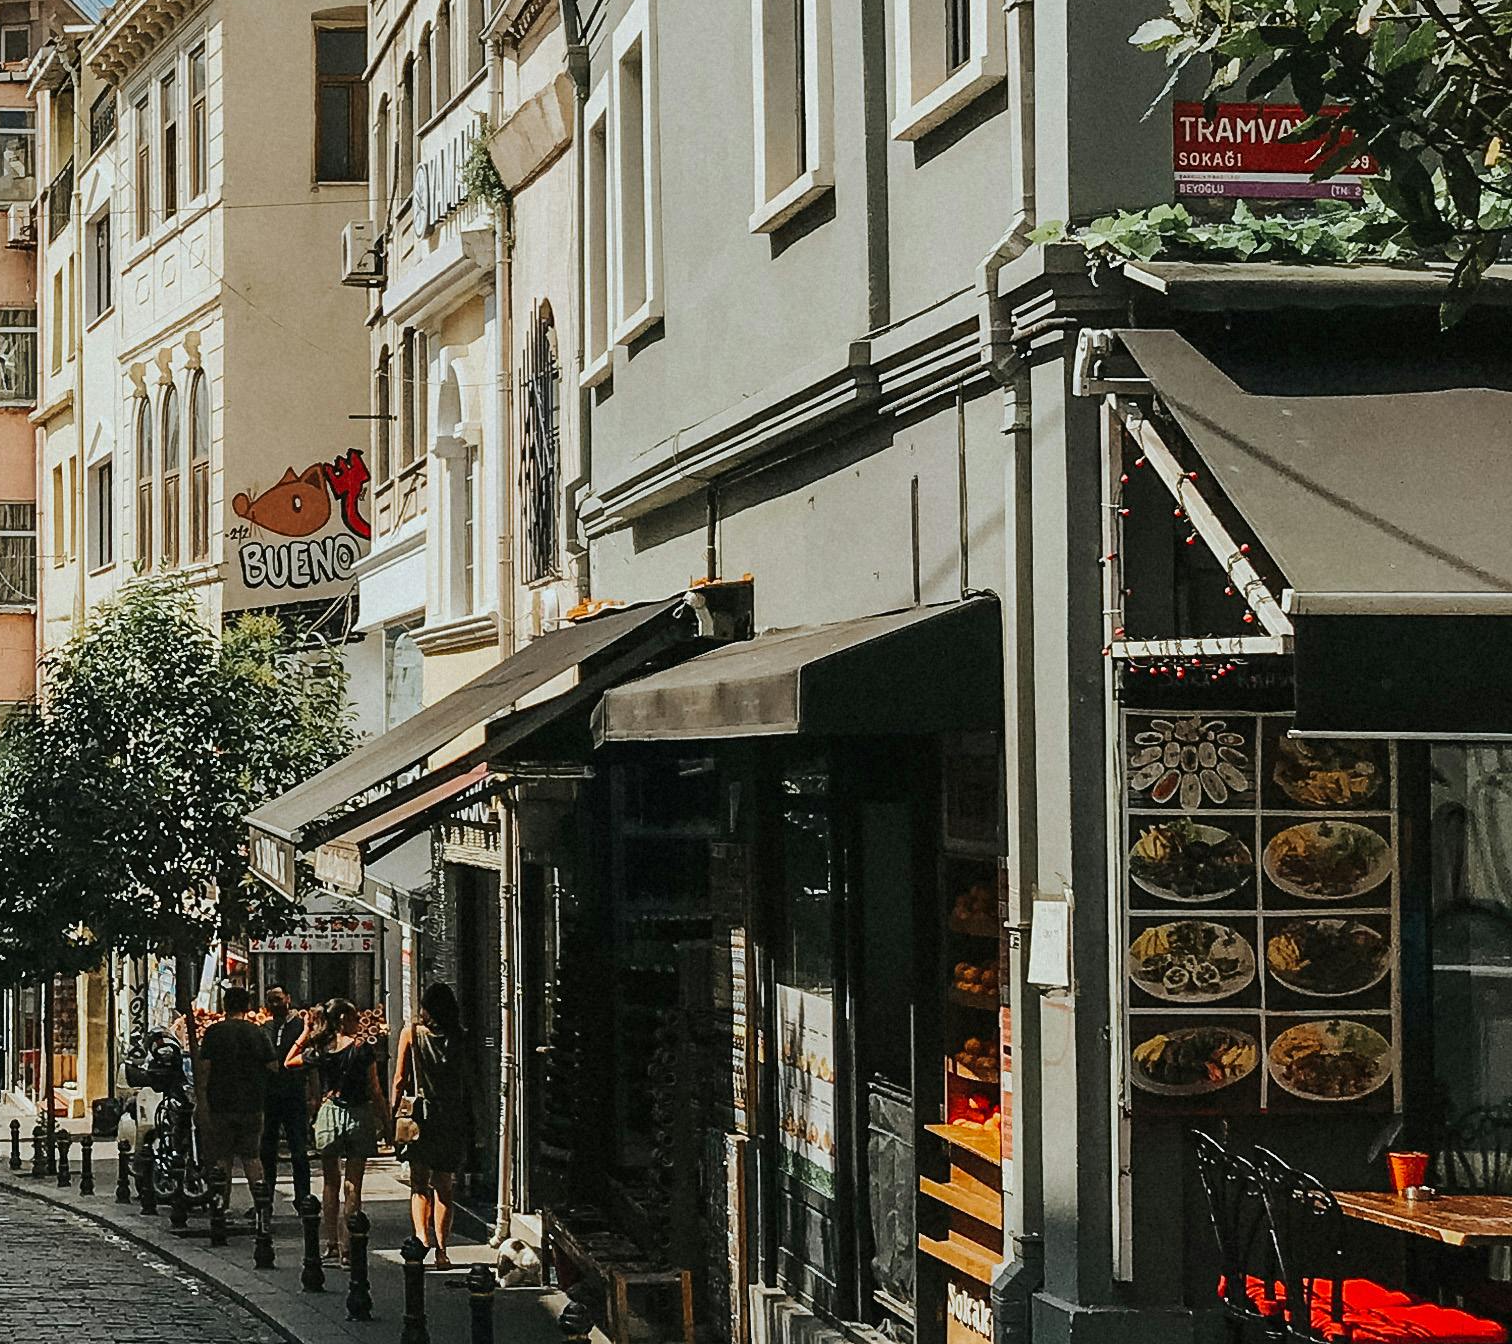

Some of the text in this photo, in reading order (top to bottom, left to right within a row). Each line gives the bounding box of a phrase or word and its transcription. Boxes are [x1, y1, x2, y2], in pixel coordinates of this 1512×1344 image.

[1179, 116, 1302, 145] TRAMVA
[1178, 151, 1242, 167] SOKAĞI
[238, 533, 362, 589] BUENO
